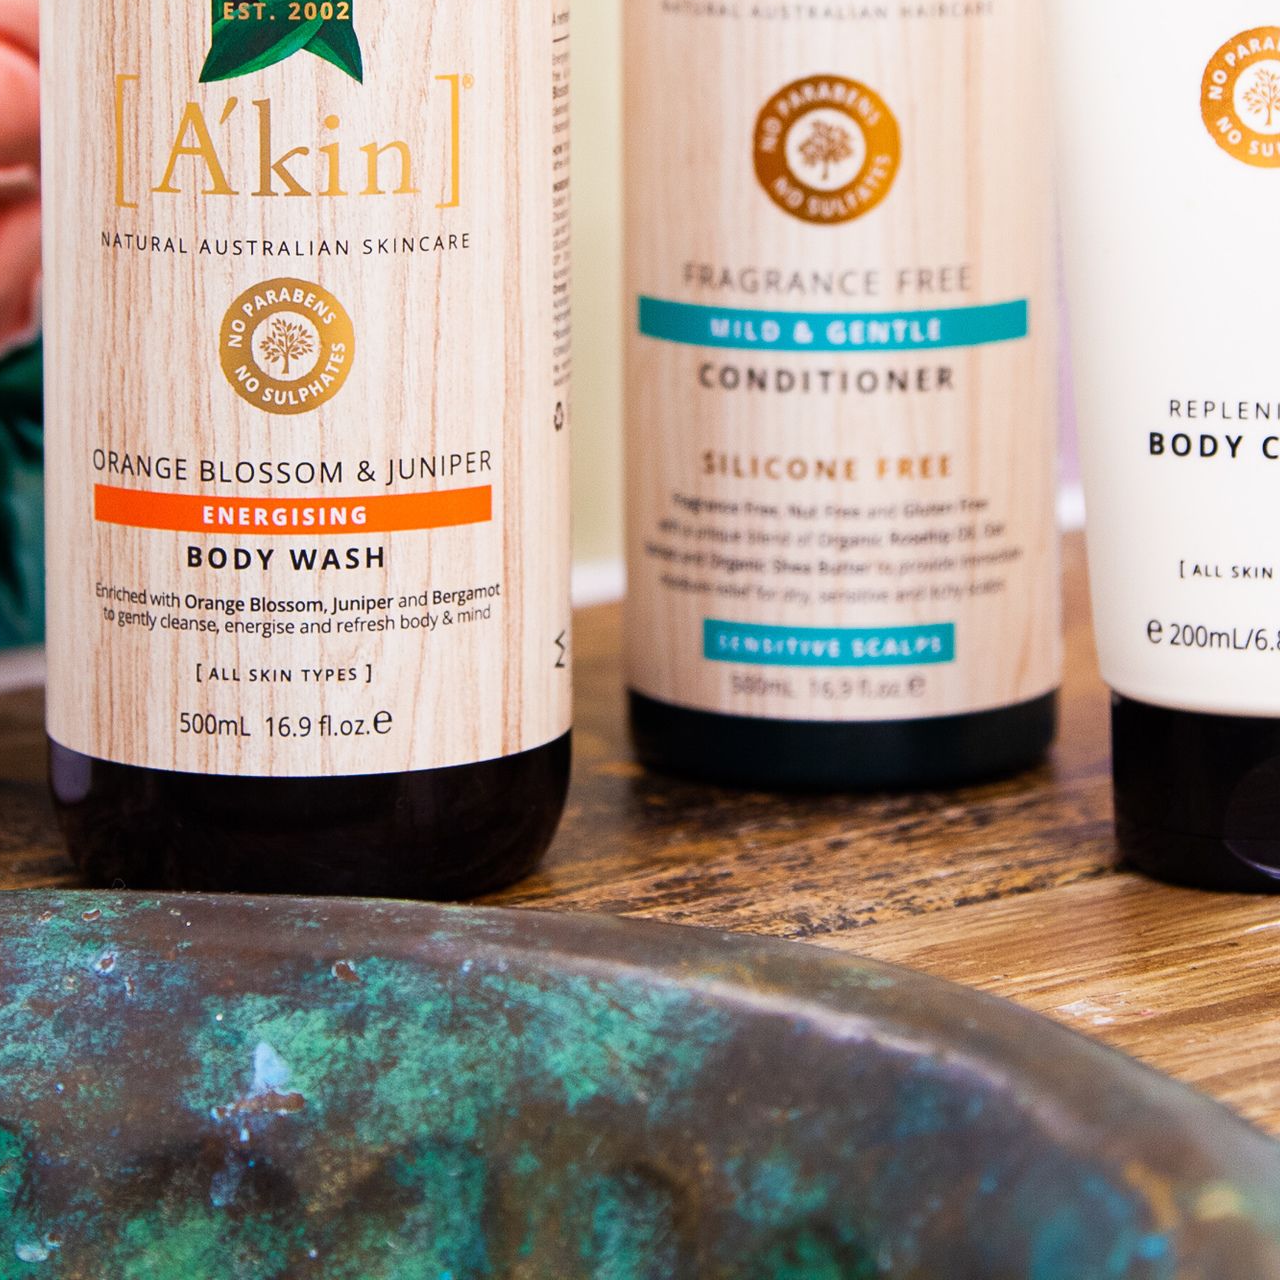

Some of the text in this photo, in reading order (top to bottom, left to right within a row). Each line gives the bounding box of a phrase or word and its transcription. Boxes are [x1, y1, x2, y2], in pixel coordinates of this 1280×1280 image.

[223, 1, 351, 21] EST. 2002
[751, 3, 888, 21] AUSTRALIAN
[1208, 68, 1228, 101] NO
[778, 82, 881, 126] PARABENS
[1215, 115, 1241, 145] NO
[101, 231, 471, 257] NATURAL AUSTRALIAN SKINCARE
[682, 262, 972, 296] FRAGRANCE FREE
[227, 287, 337, 349] NO PARABENS
[710, 318, 942, 345] MILD & GENTLE
[234, 341, 346, 406] NO SULPHATES
[698, 362, 956, 394] CONDITIONER
[1149, 431, 1243, 458] BODY
[92, 448, 492, 486] ORANGE BLOSSOM & JUNIPER
[702, 451, 953, 481] SILICONE FREE
[202, 505, 368, 527] ENERGISING
[186, 546, 386, 570] BODY WASH
[1231, 564, 1274, 580] SKIN
[95, 581, 501, 616] Enriched with Orange Blossom, Juniper and Bergamot
[103, 604, 492, 639] to gently cleanse, energise and refresh body & mind
[718, 634, 942, 659] SENSITIVE SCALPS
[249, 667, 293, 683] SKIN
[179, 711, 252, 737] 500mL
[265, 715, 312, 738] 16.9
